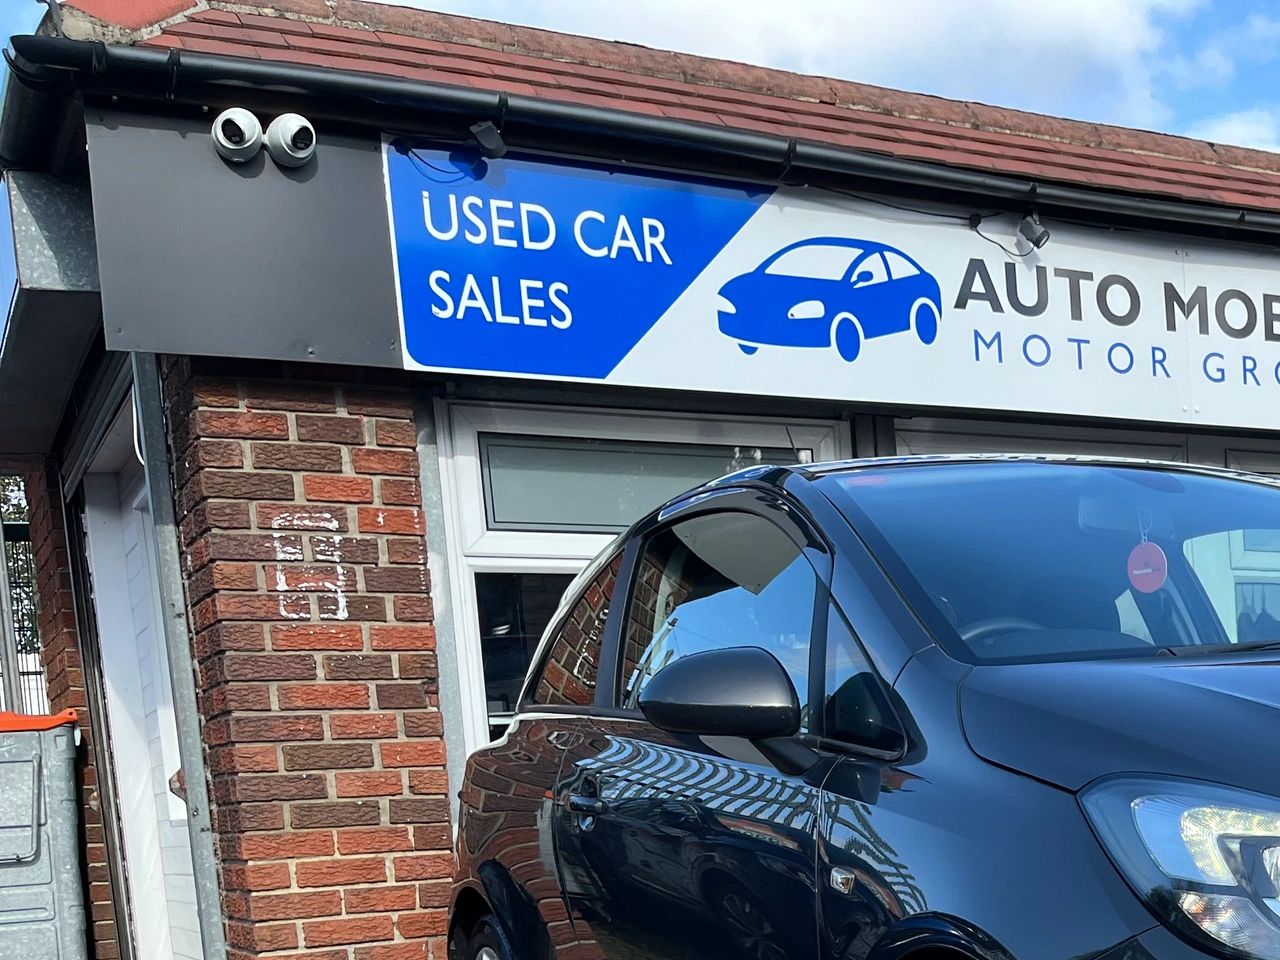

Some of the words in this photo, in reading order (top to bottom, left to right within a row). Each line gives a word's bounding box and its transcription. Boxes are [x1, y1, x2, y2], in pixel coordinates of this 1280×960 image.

[422, 190, 556, 251] USED
[574, 210, 673, 265] CAR
[429, 269, 573, 330] SALES
[953, 258, 1141, 327] AUTO
[973, 329, 1172, 379] MOTOR
